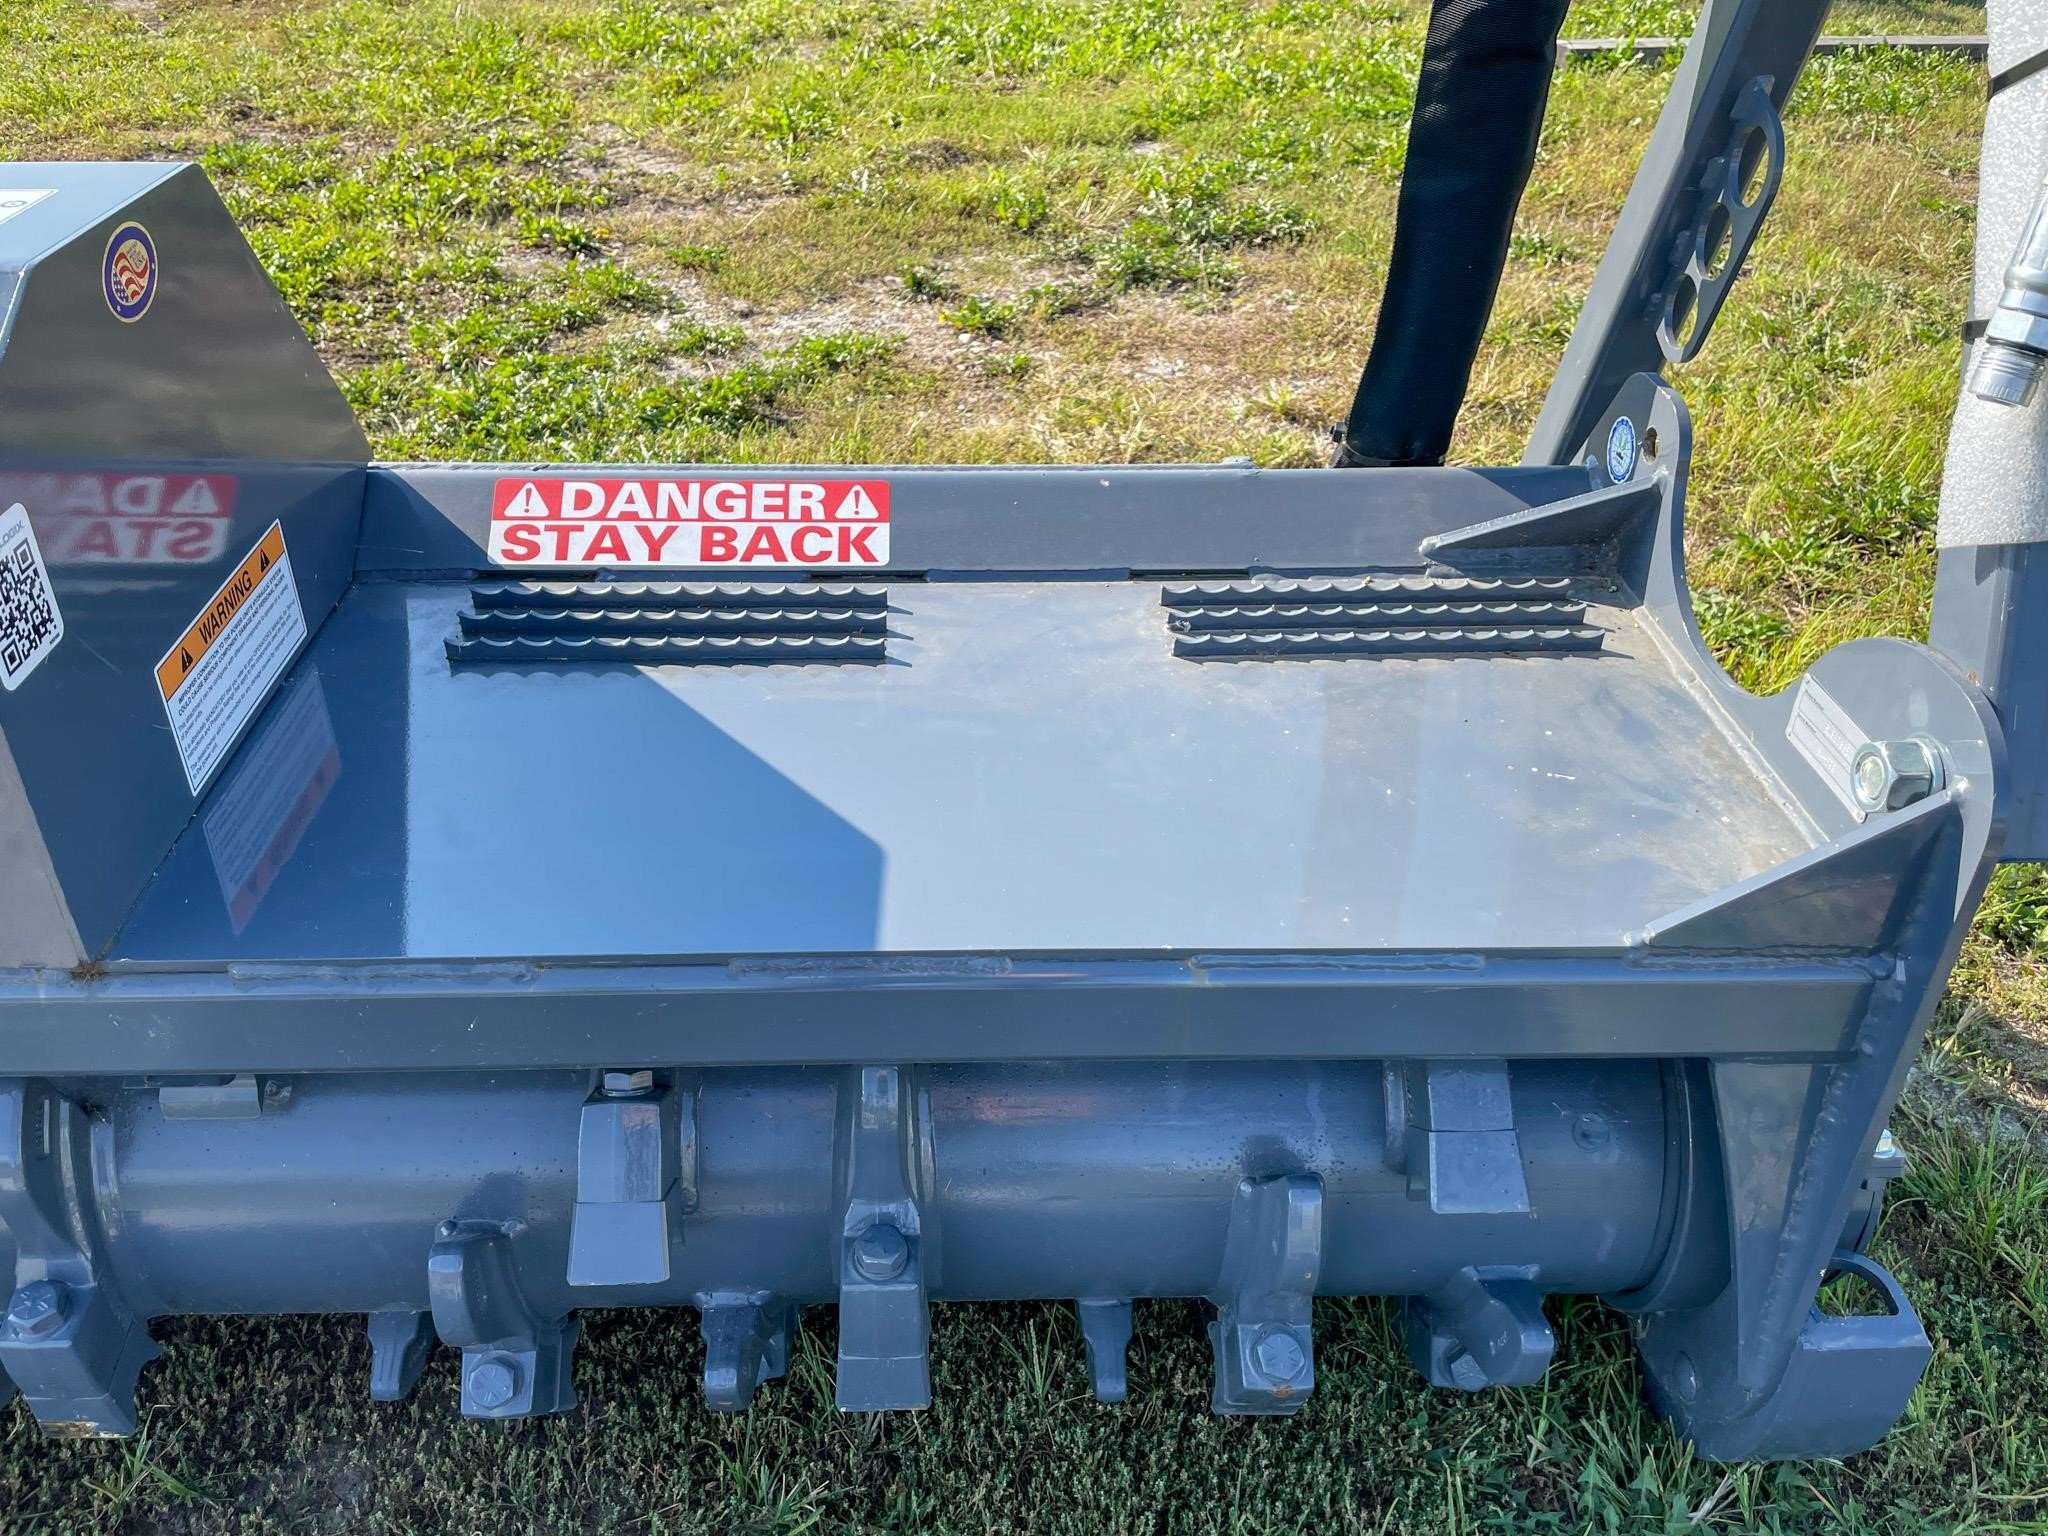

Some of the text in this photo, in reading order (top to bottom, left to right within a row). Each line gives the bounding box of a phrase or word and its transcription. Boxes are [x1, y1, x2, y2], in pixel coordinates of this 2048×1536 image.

[560, 482, 827, 520] DANGER
[500, 523, 879, 563] STAY BACK
[198, 567, 252, 647] WARNING
